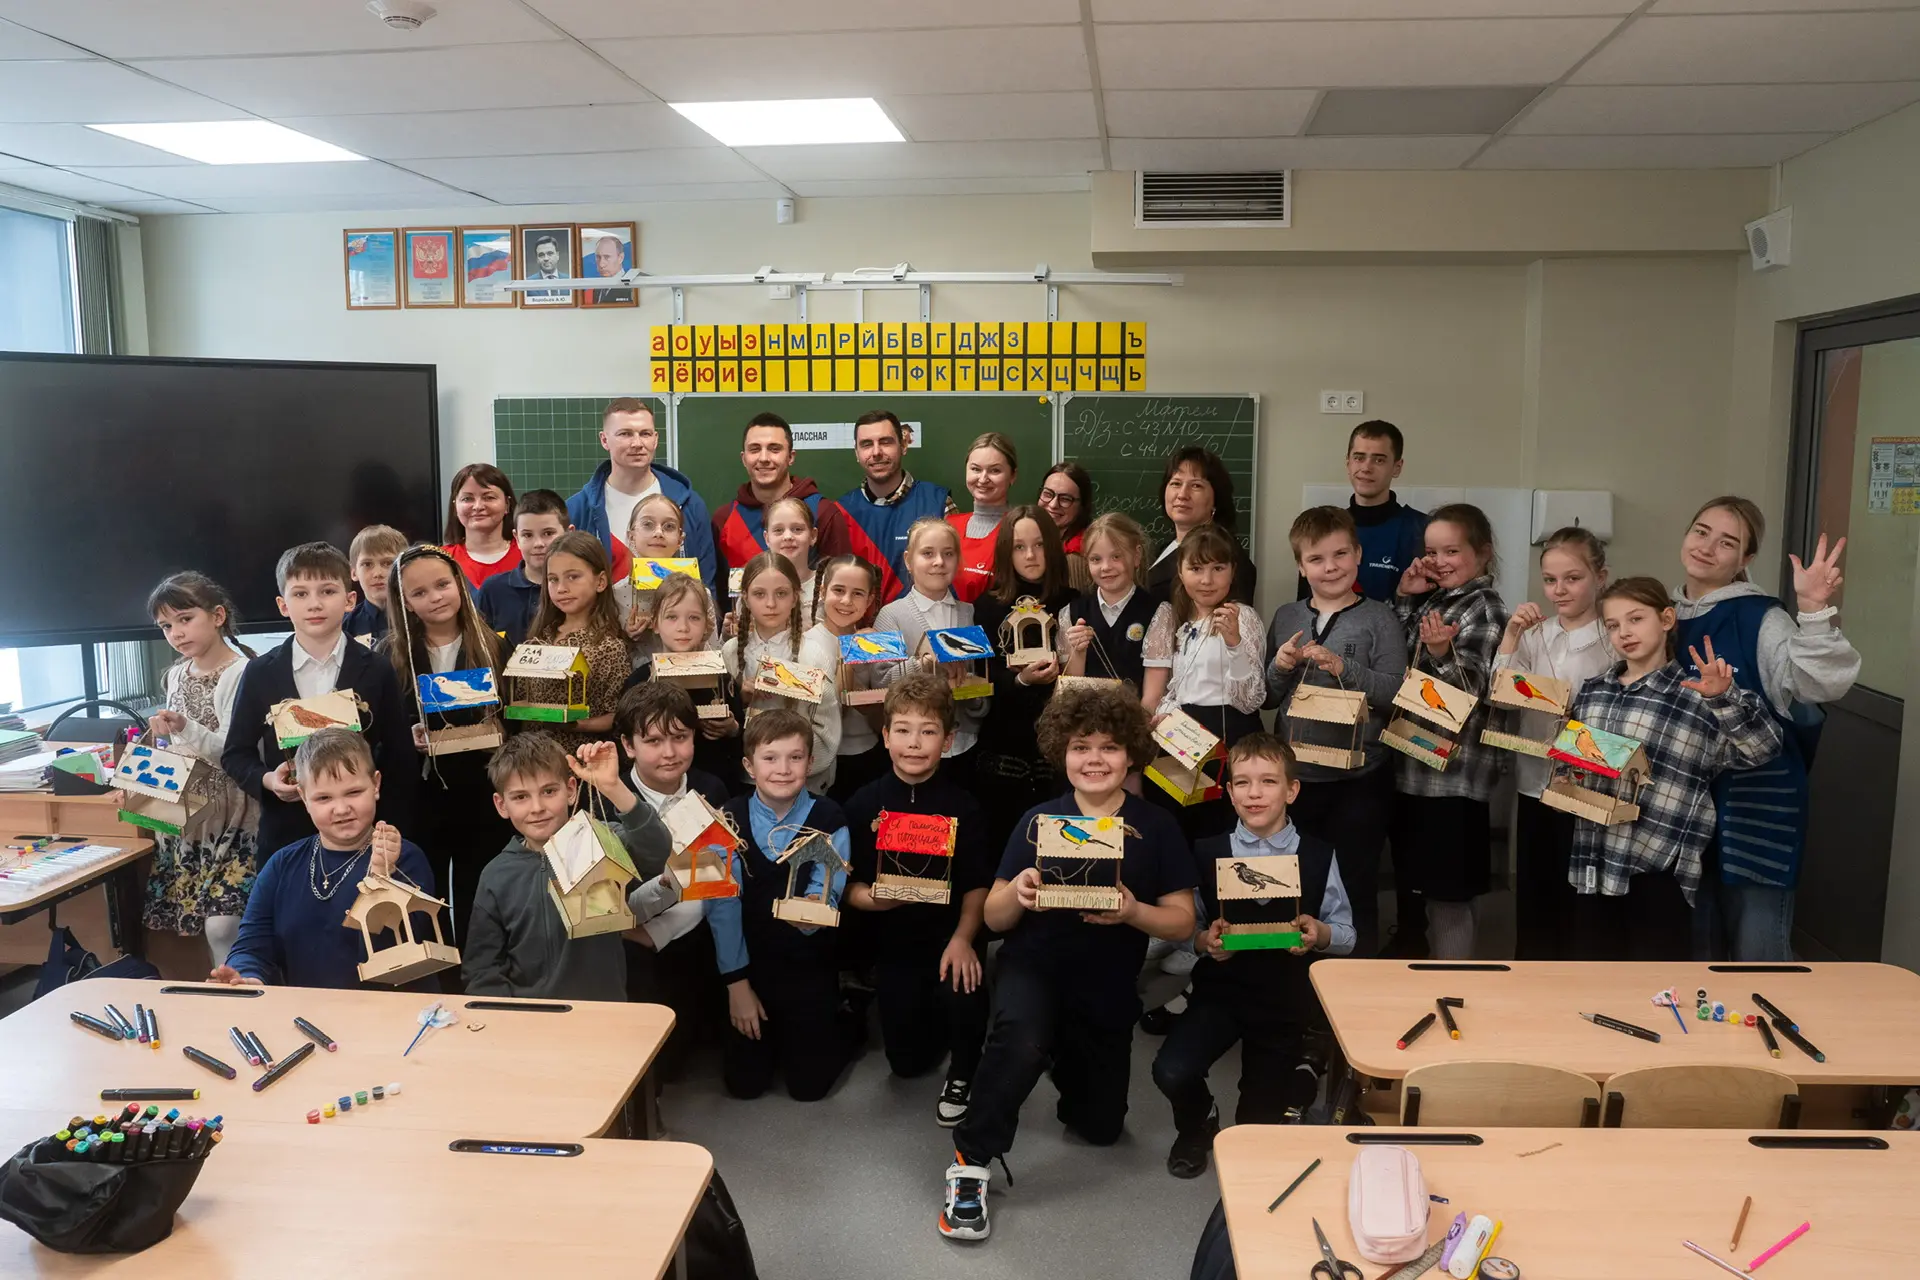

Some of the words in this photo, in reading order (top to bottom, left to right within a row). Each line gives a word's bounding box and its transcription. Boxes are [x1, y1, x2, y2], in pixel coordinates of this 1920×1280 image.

[653, 336, 664, 351] а
[676, 336, 688, 350] о
[700, 336, 711, 355] у
[721, 335, 735, 349] ы
[745, 334, 756, 349] э
[769, 335, 780, 349] Н
[792, 335, 804, 349] М
[816, 334, 826, 348] Л
[840, 334, 850, 348] Р
[863, 330, 874, 348] Й
[888, 334, 898, 348] Б
[912, 333, 922, 348] В
[937, 333, 946, 348] Г
[959, 333, 971, 351] Д
[981, 333, 998, 347] Ж
[1008, 332, 1018, 347] З
[1128, 332, 1142, 347] Ъ
[654, 368, 665, 382] я
[676, 363, 688, 382] ё
[698, 368, 714, 382] ю
[723, 368, 734, 382] и
[745, 368, 757, 382] е
[887, 366, 898, 379] П
[910, 366, 924, 380] Ф
[936, 366, 946, 380] К
[960, 366, 971, 380] Т
[982, 366, 997, 380] Ш
[1031, 366, 1043, 381] Х
[1056, 366, 1068, 384] Ц
[1080, 366, 1091, 380] Ч
[1102, 366, 1119, 384] Щ
[1130, 366, 1141, 381] Ь
[1140, 420, 1160, 436] 43
[1138, 443, 1157, 457] 44
